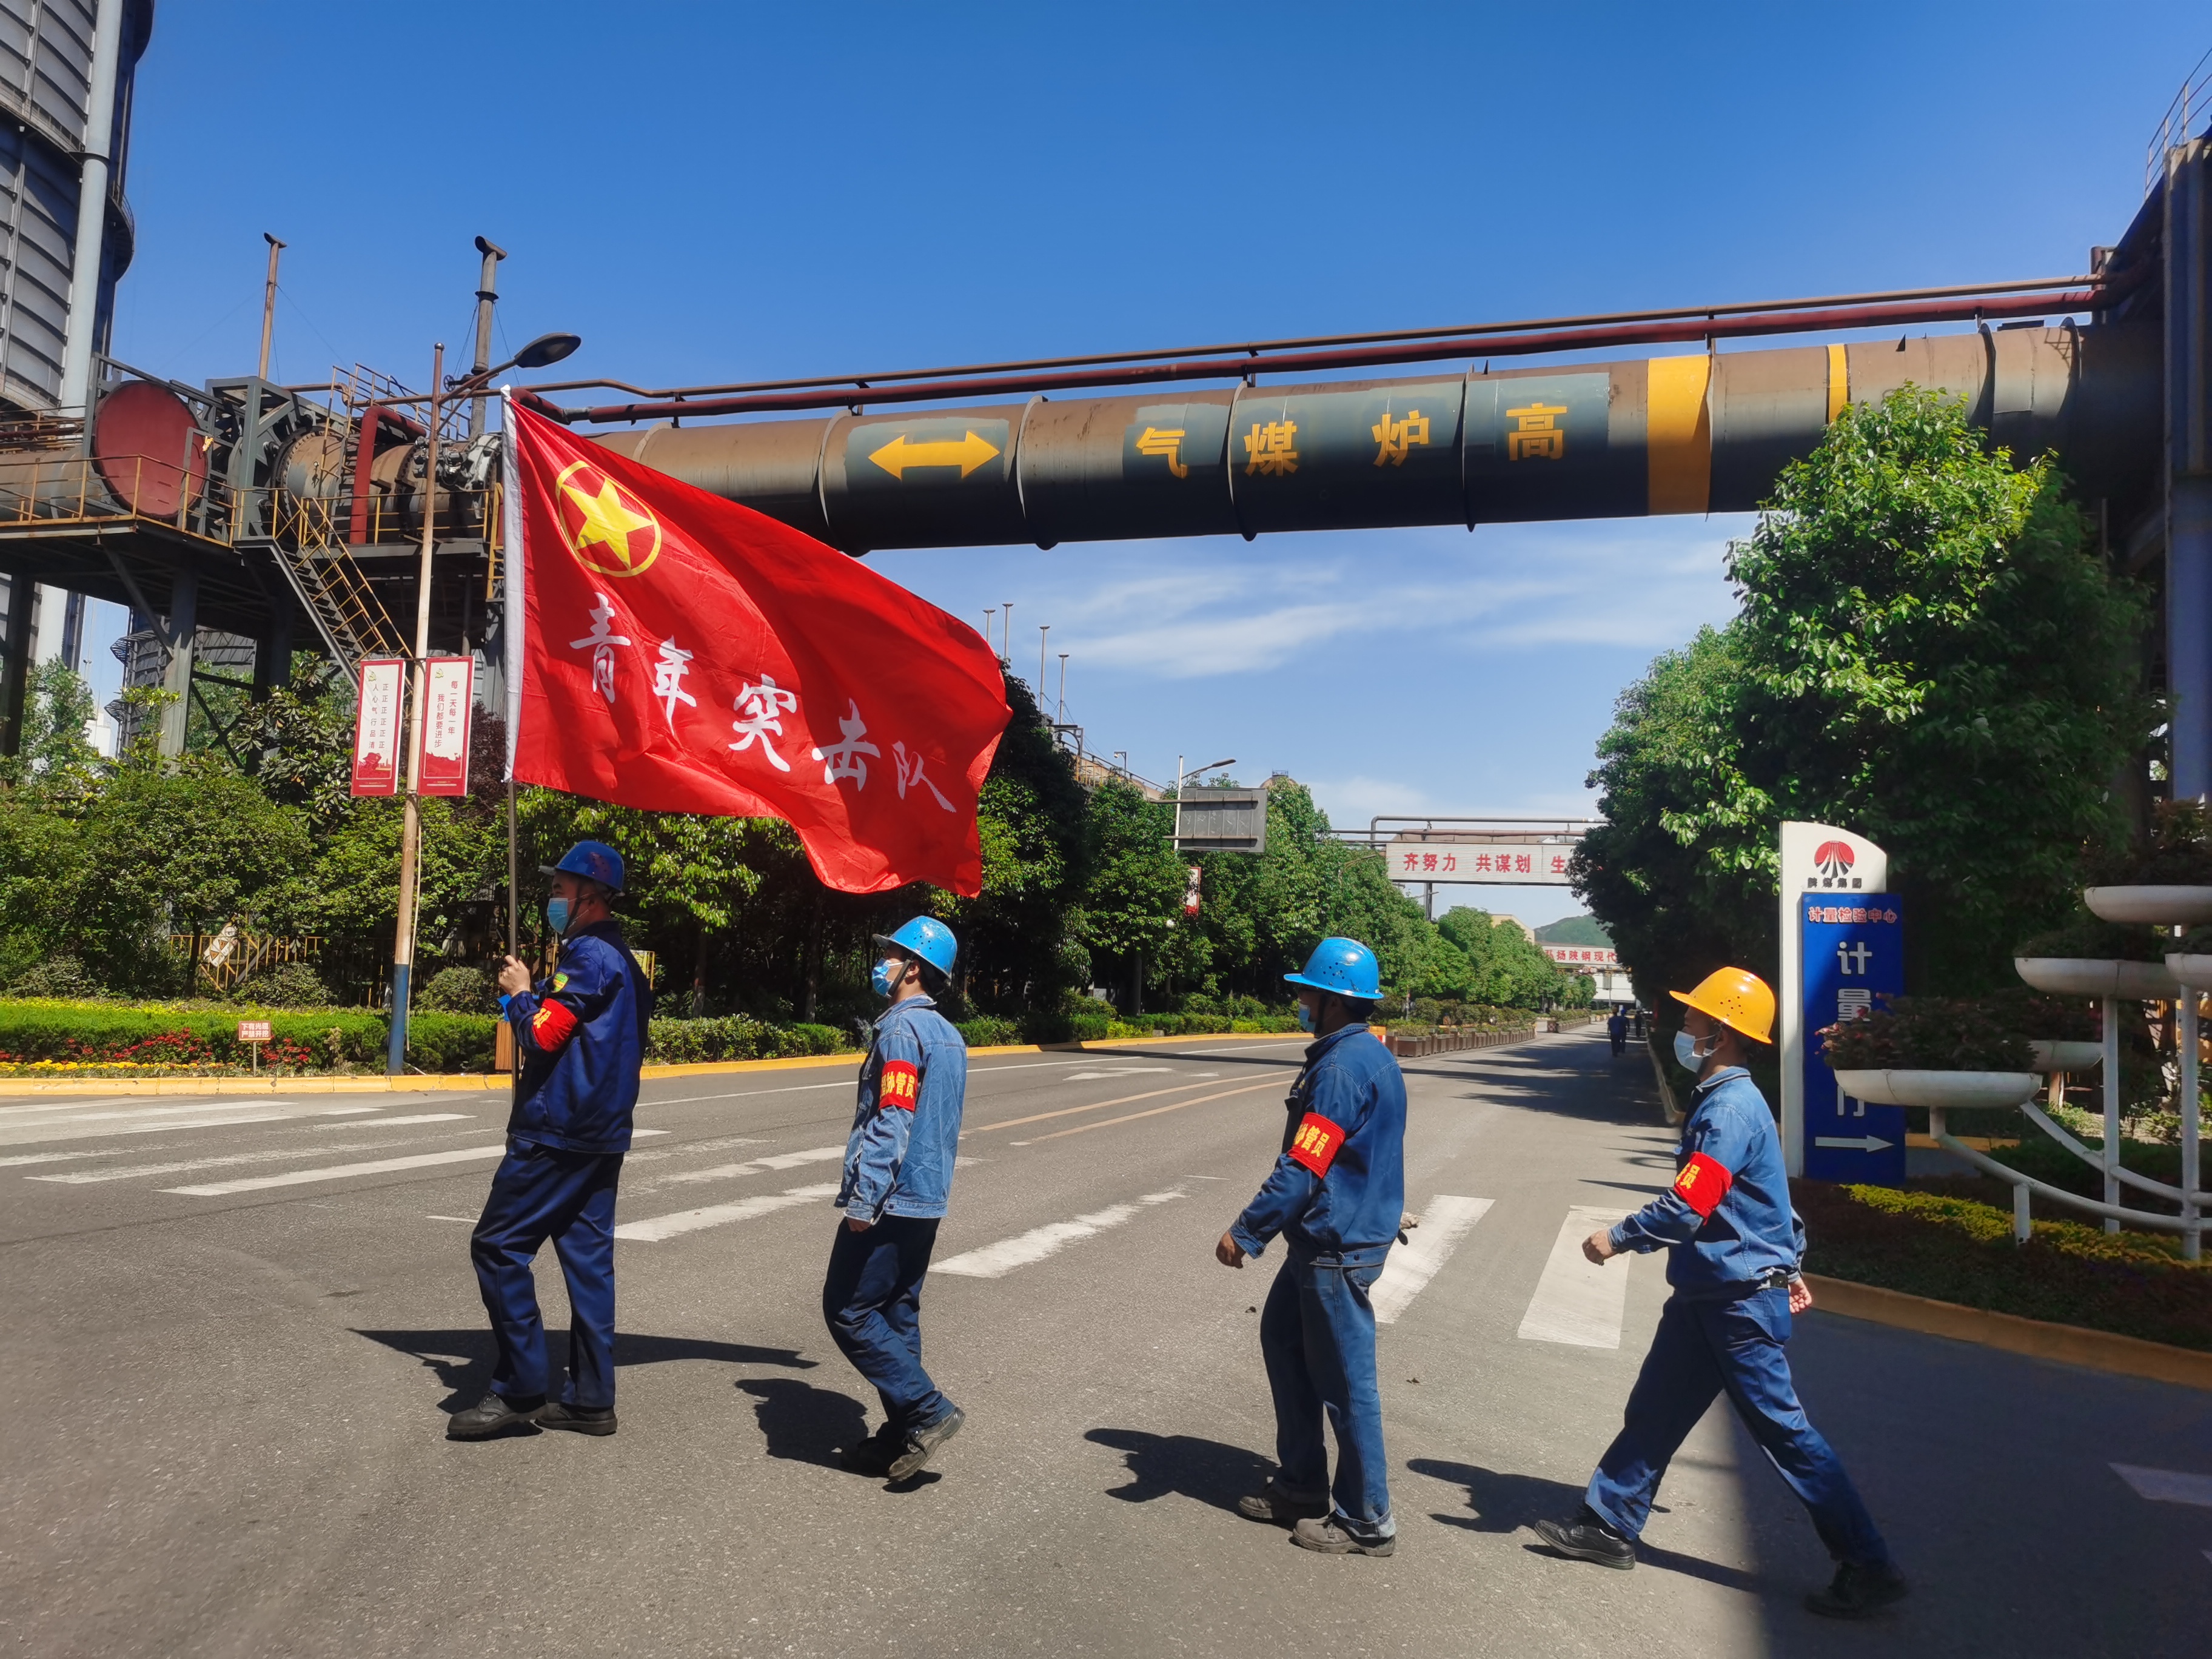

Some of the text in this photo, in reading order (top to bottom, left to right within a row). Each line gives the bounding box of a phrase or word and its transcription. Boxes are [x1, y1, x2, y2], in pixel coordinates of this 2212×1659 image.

[434, 693, 445, 748] 我们都要进步
[569, 592, 957, 813] 青年突击队
[1404, 852, 1456, 872] 齐努力
[1475, 854, 1531, 873] 共谋划
[1808, 906, 1897, 923] 计量检验中心
